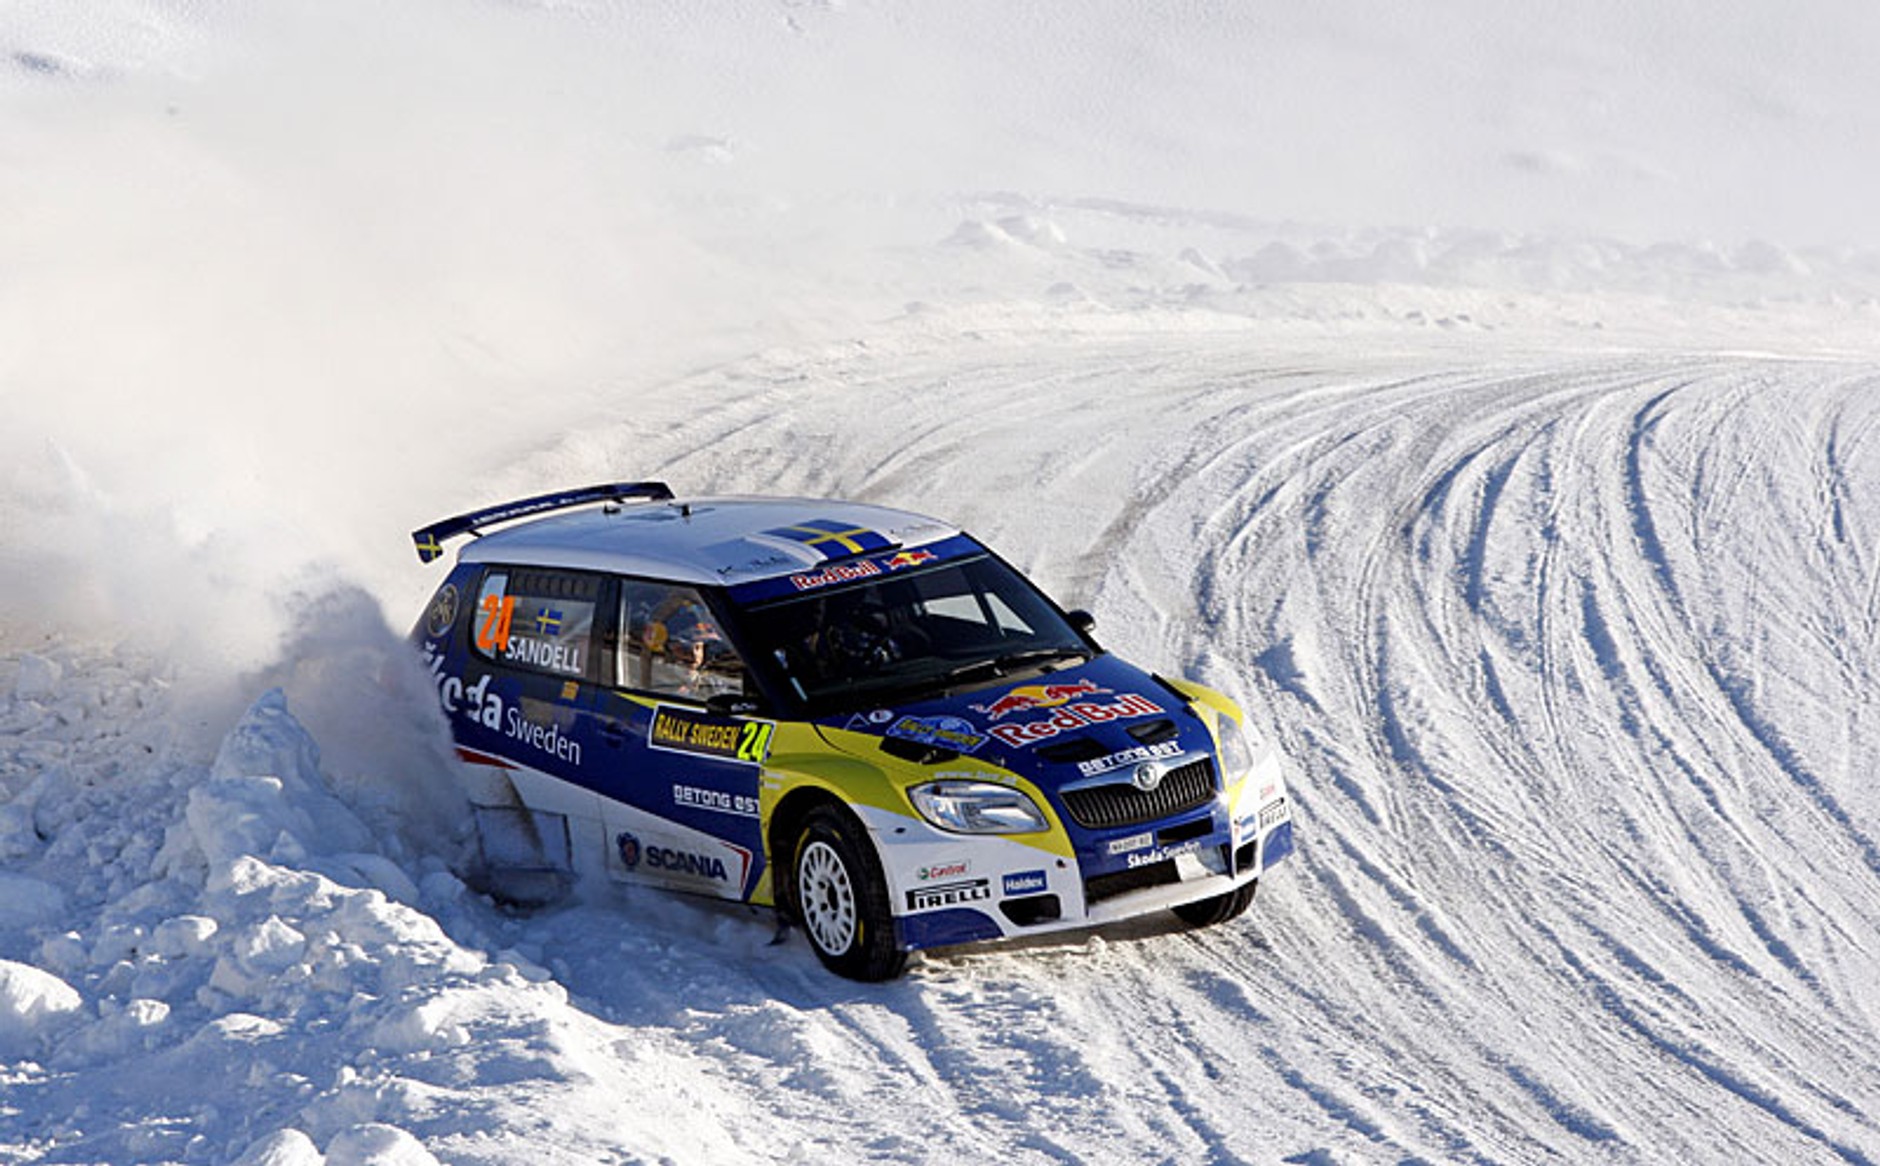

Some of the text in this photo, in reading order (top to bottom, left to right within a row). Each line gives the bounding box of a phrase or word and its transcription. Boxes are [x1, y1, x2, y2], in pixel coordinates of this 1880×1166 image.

[790, 559, 882, 591] Red Bull
[476, 593, 515, 651] 24
[505, 636, 582, 673] SANDELL
[505, 707, 581, 765] Sweden
[654, 713, 741, 751] RALLY SWEDEN
[986, 694, 1166, 748] Red Bull
[737, 721, 772, 762] 24
[673, 785, 731, 807] BETONG
[646, 846, 728, 881] SCANIA
[905, 878, 991, 910] PIRELLI
[1006, 875, 1044, 891] Haldex
